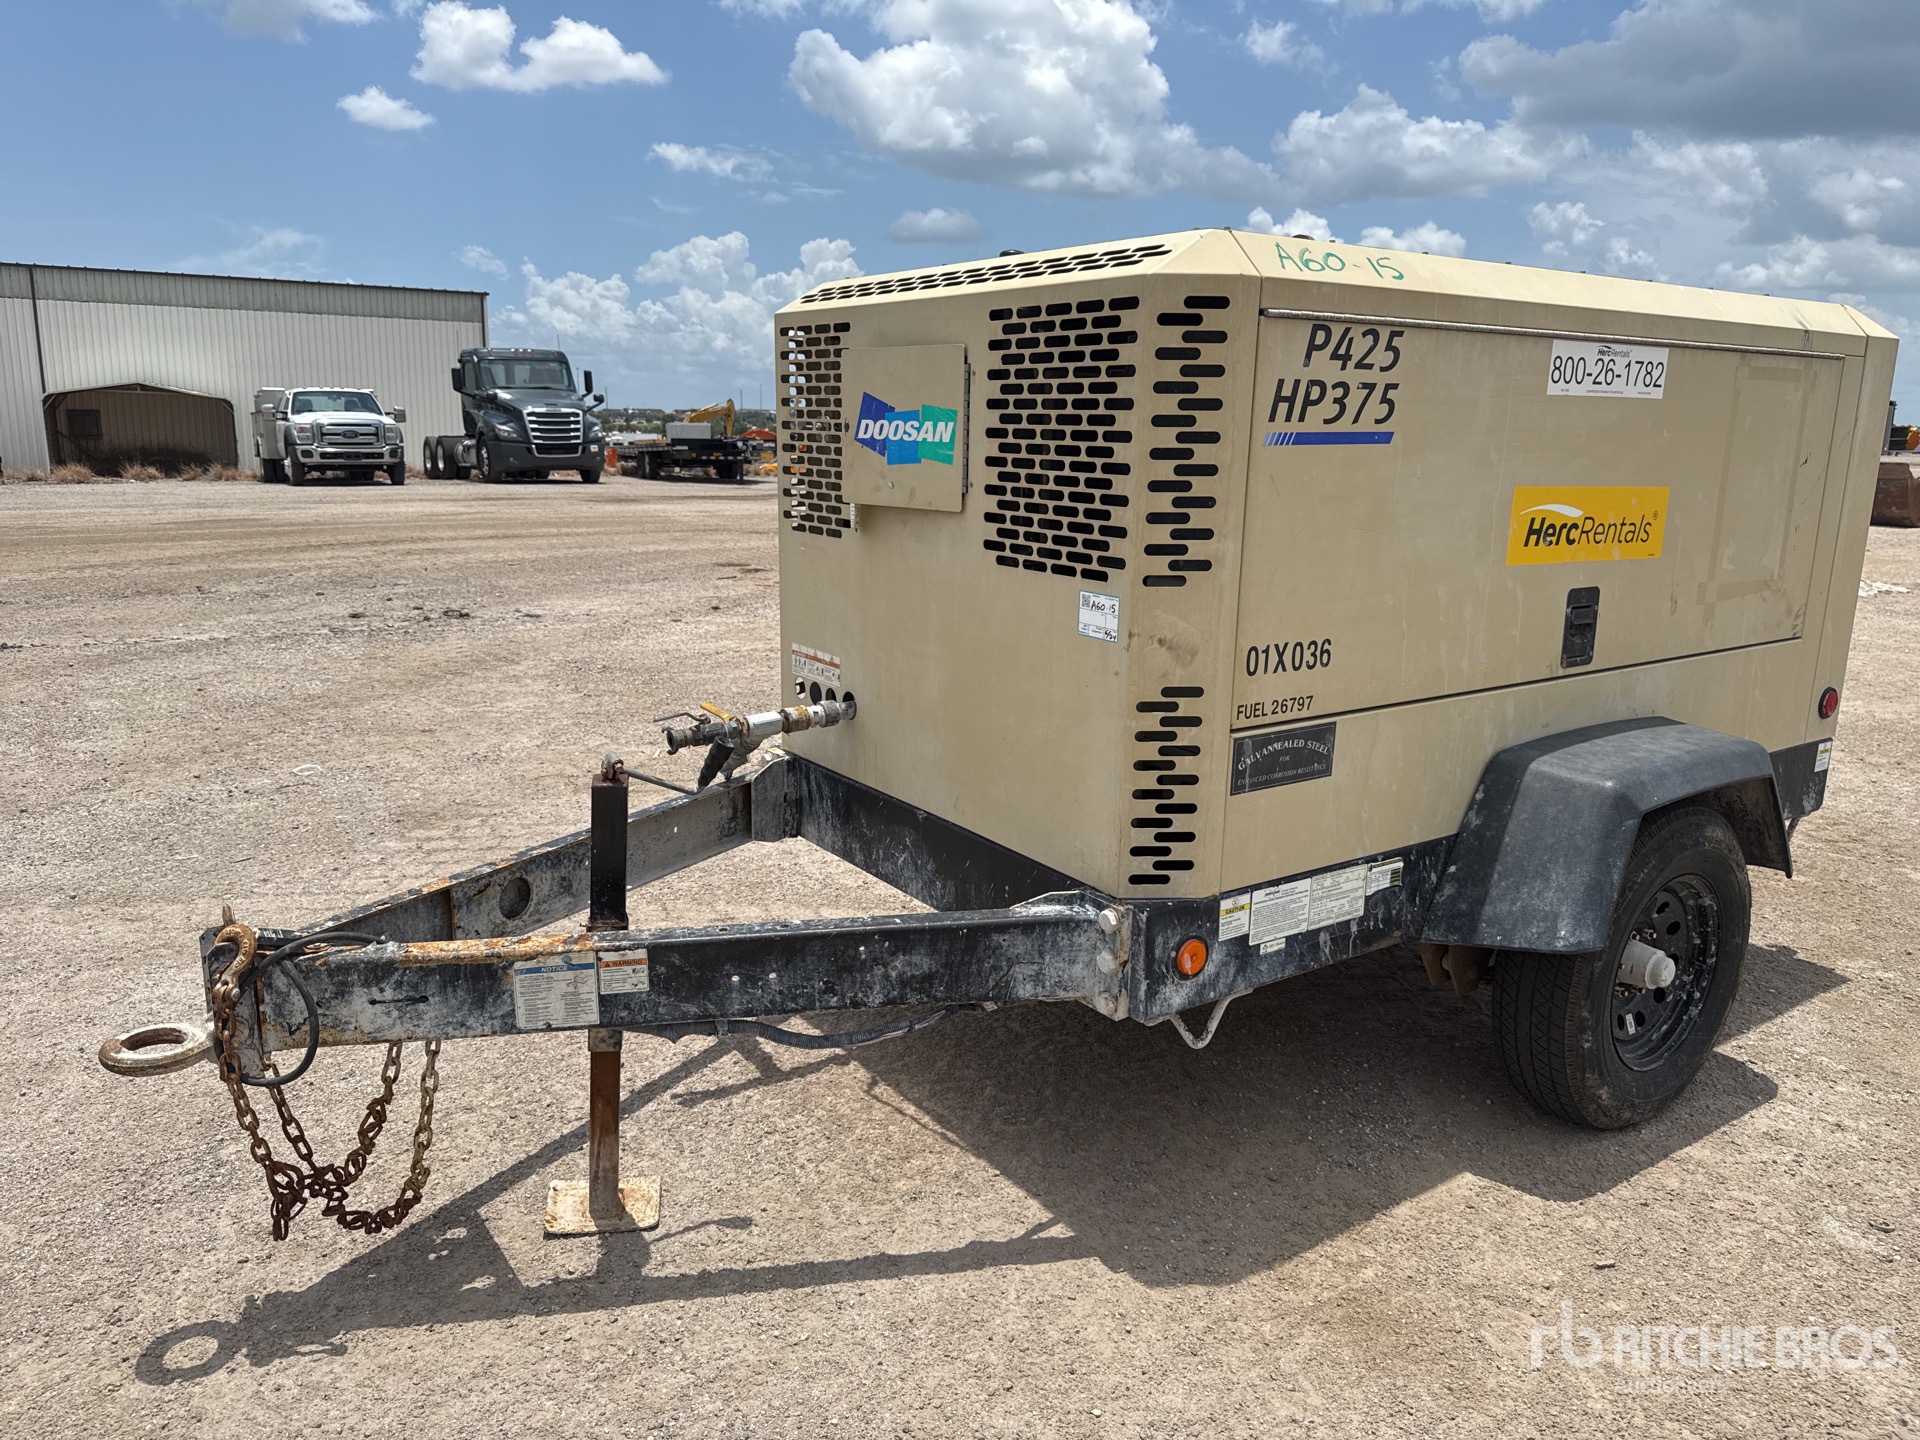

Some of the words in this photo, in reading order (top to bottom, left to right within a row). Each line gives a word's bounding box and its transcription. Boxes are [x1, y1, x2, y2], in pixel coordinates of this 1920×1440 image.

[1303, 323, 1405, 372] P425
[1551, 355, 1664, 388] 800-26-1782
[1268, 378, 1400, 425] HP375
[857, 419, 954, 442] DOOSAN
[1246, 638, 1332, 677] 01X036
[1236, 701, 1268, 720] FUEL
[1271, 695, 1314, 715] 26797
[1238, 739, 1305, 771] GALVANNEALED
[1306, 740, 1329, 755] STEEL
[1279, 755, 1291, 763] FOR
[1267, 768, 1297, 780] CORROSION
[1297, 763, 1328, 775] RESISTANCE
[1225, 905, 1244, 914] CAUTION
[612, 959, 643, 967] WARNING
